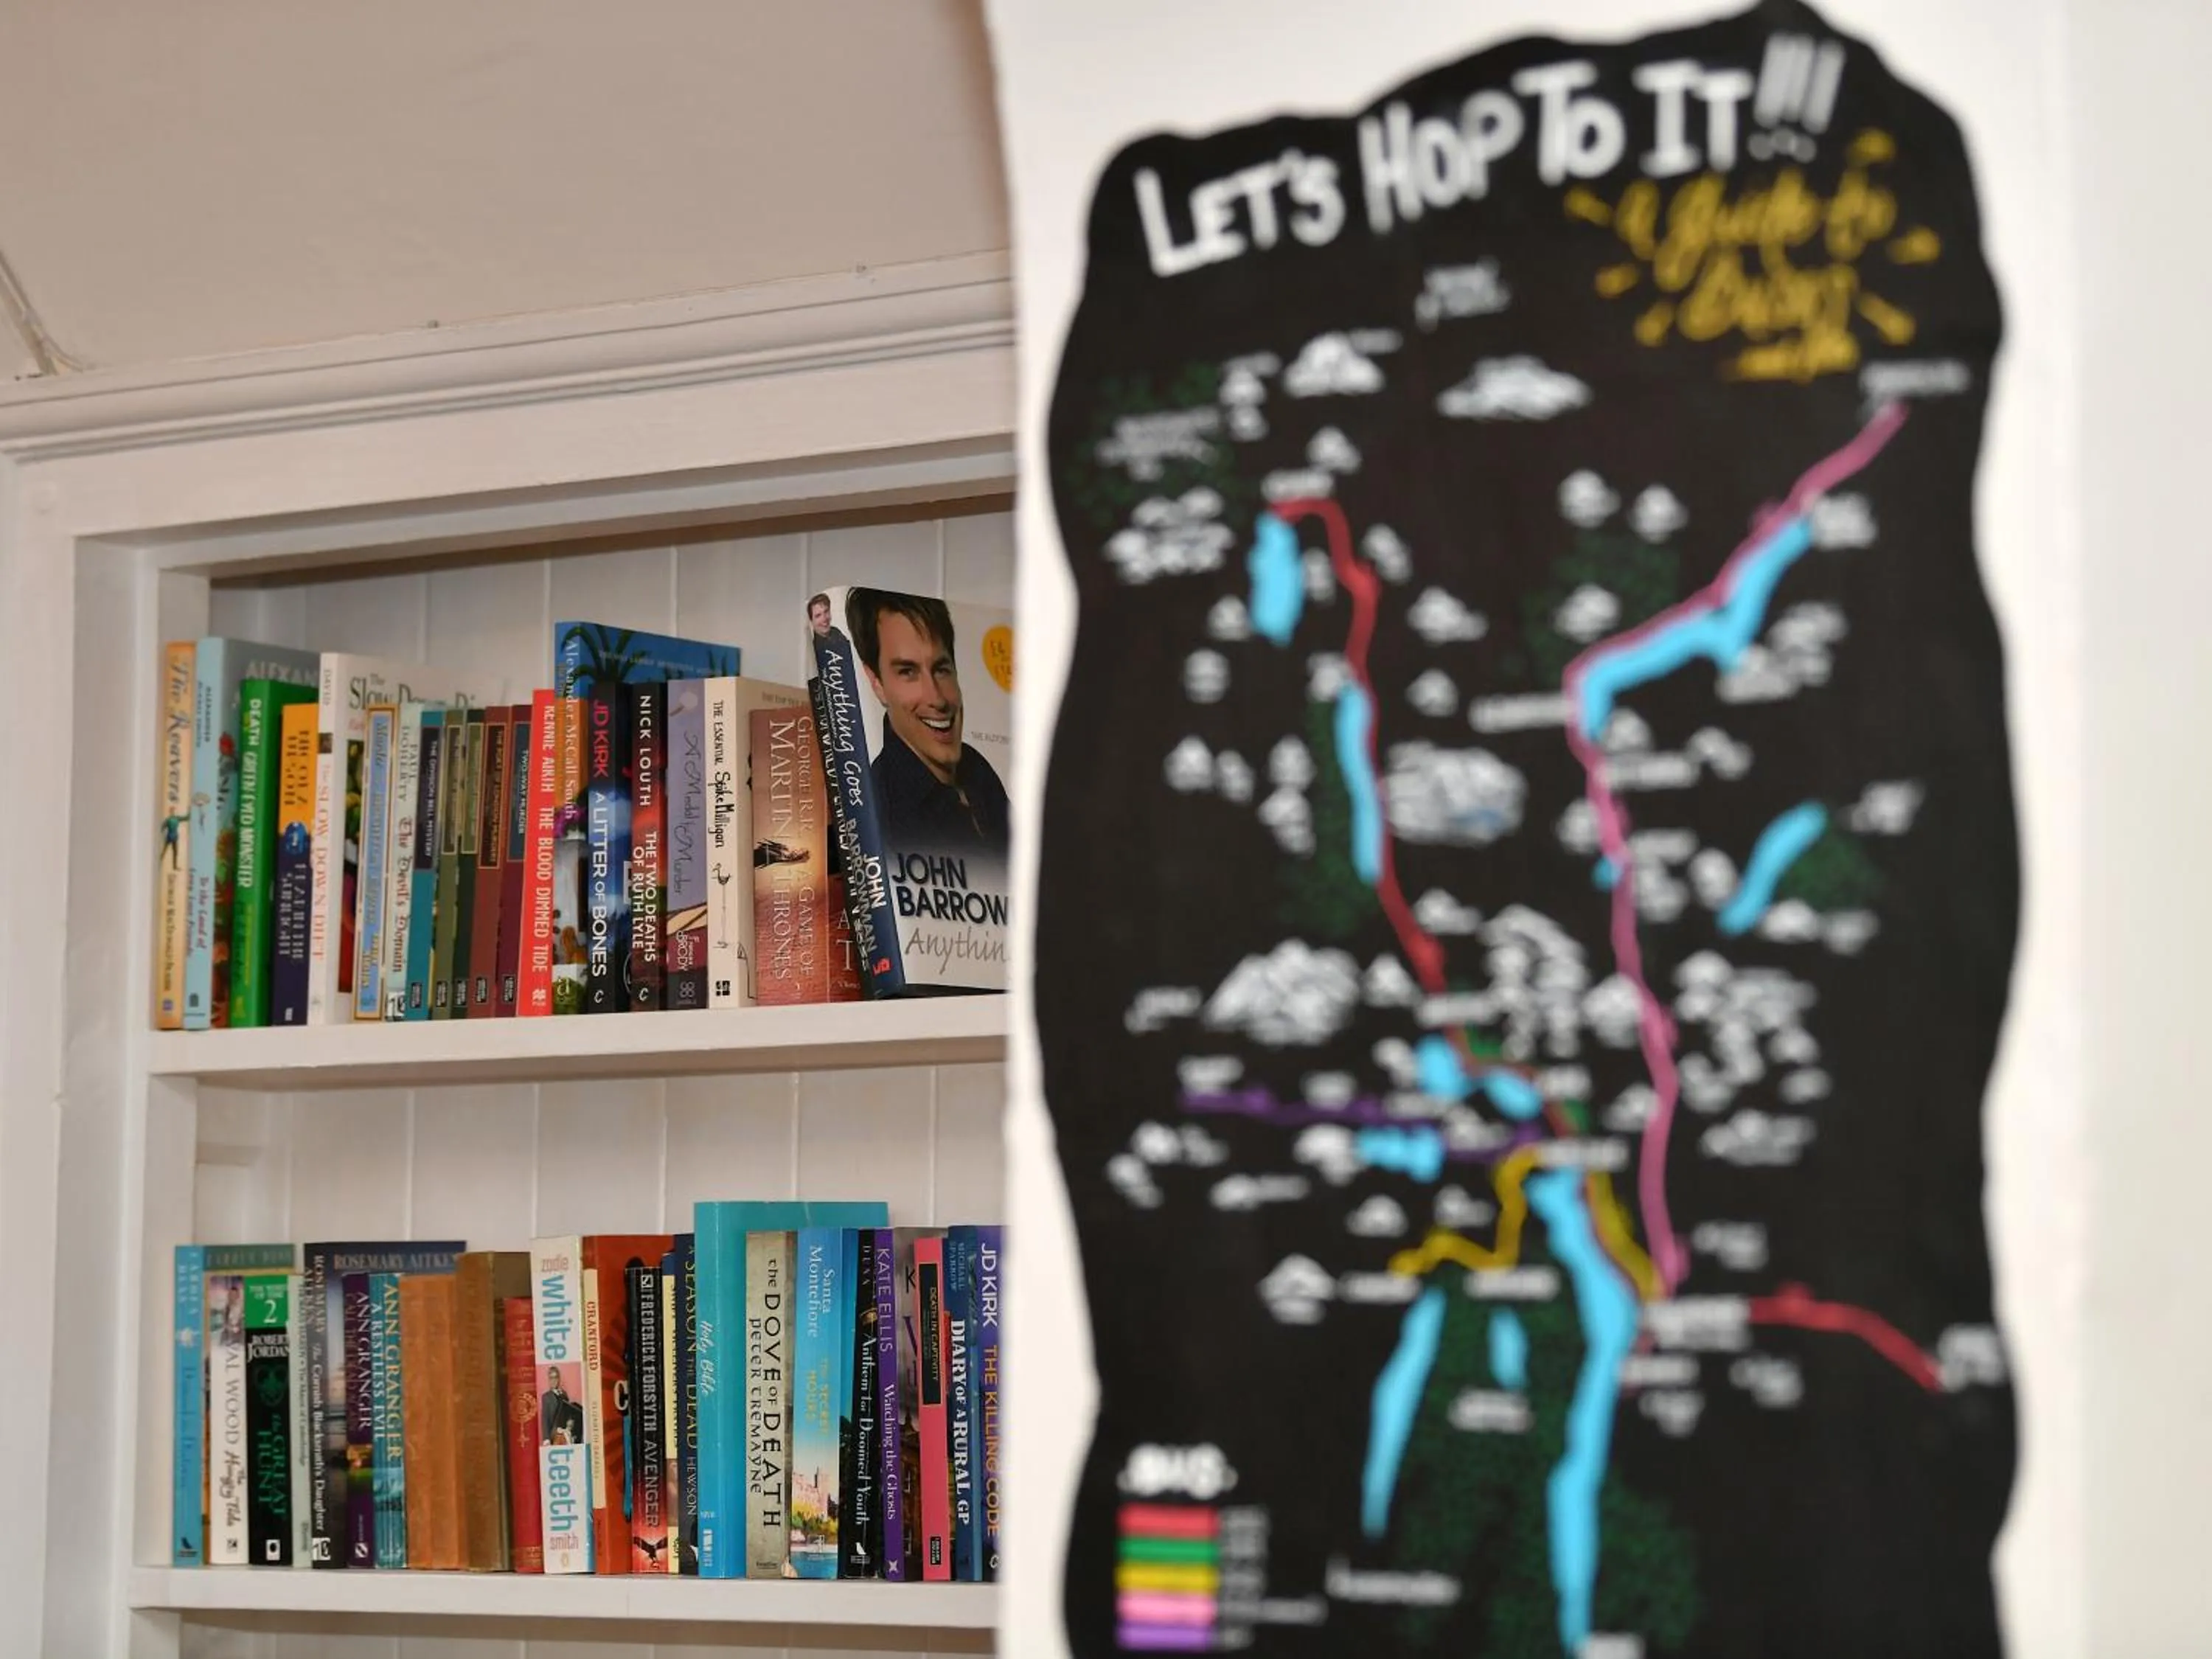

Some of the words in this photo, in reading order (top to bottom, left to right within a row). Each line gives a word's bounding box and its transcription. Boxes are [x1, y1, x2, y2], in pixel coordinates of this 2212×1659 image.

[1133, 146, 1346, 277] LET'S
[1357, 89, 1525, 232] HOP
[565, 640, 580, 720] Alexander
[248, 698, 262, 745] DEATH
[593, 700, 610, 726] JD
[639, 695, 652, 740] NICK
[713, 700, 724, 717] THE
[822, 649, 856, 752] Anything
[843, 760, 863, 807] Goes
[166, 706, 191, 803] Reavers
[566, 725, 578, 774] McCall
[593, 730, 610, 778] KIRK
[796, 715, 814, 789] GEORGE
[564, 779, 577, 819] Smith
[593, 791, 605, 804] A
[639, 748, 652, 807] LOUTH
[708, 771, 733, 803] Spike
[768, 718, 796, 838] MARTIN
[315, 785, 330, 843] SLOW
[398, 815, 414, 849] The
[424, 820, 434, 857] MYSTERY
[540, 807, 554, 830] THE
[708, 803, 735, 848] Milligan
[237, 827, 253, 888] MONSTER
[538, 838, 554, 881] BLOOD
[591, 807, 608, 877] LITTER
[633, 846, 644, 866] OF
[644, 831, 657, 859] THE
[314, 848, 328, 906] DOWN
[397, 855, 414, 906] Devil's
[594, 880, 605, 902] OF
[633, 873, 644, 913] RUTH
[644, 861, 656, 900] TWO
[846, 818, 878, 953] BARROWMAN
[863, 853, 887, 909] JOHN
[891, 852, 968, 889] JOHN
[534, 887, 551, 938] DIMMED
[772, 869, 793, 980] THRONES
[799, 886, 815, 946] GAME
[896, 886, 1009, 926] BARROW
[313, 914, 326, 961] DIET
[392, 914, 411, 973] Domain
[591, 906, 608, 976] BONES
[632, 917, 644, 949] LYLE
[644, 905, 656, 962] DEATHS
[904, 926, 1006, 975] Anythin
[532, 944, 549, 973] TIDE
[800, 951, 815, 976] OF
[334, 1253, 404, 1270] ROSEMARY
[877, 1248, 892, 1295] KATE
[981, 1242, 997, 1271] JD
[263, 1299, 277, 1323] 2
[356, 1291, 372, 1332] ANN
[371, 1302, 383, 1315] A
[383, 1284, 400, 1337] ANN
[685, 1261, 698, 1354] SEASON
[807, 1245, 824, 1338] Montefiore
[821, 1268, 836, 1314] Santa
[929, 1287, 938, 1319] DEATH
[981, 1276, 998, 1327] KIRK
[541, 1275, 573, 1360] white
[586, 1301, 599, 1371] CRANFORD
[640, 1293, 655, 1363] FREDERICK
[762, 1293, 782, 1381] DOVE
[878, 1303, 893, 1352] ELLIS
[931, 1321, 938, 1331] IN
[372, 1321, 384, 1399] RESTLESS
[860, 1333, 877, 1391] Anthem
[931, 1334, 939, 1381] CAPTIVITY
[950, 1319, 967, 1387] DIARY
[984, 1345, 998, 1385] THE
[310, 1364, 324, 1408] Cornish
[357, 1337, 372, 1431] GRANGER
[385, 1344, 403, 1461] GRANGER
[641, 1365, 657, 1432] FORSYTH
[768, 1386, 779, 1405] OF
[860, 1396, 873, 1412] for
[955, 1386, 967, 1404] OF
[224, 1379, 240, 1444] WOOD
[372, 1405, 385, 1442] EVIL
[883, 1383, 897, 1448] Watching
[956, 1409, 967, 1418] A
[984, 1391, 1000, 1473] KILLING
[762, 1412, 782, 1528] DEATH
[857, 1418, 874, 1480] Doomed
[885, 1450, 897, 1472] the
[953, 1420, 971, 1495] RURAL
[312, 1479, 327, 1531] Daughter
[548, 1448, 580, 1531] teeth
[643, 1439, 659, 1528] AVENGER
[686, 1456, 698, 1516] HEWSON
[855, 1486, 873, 1526] Youth
[886, 1474, 898, 1520] Ghosts
[986, 1478, 1001, 1537] CODE
[956, 1499, 970, 1526] GP
